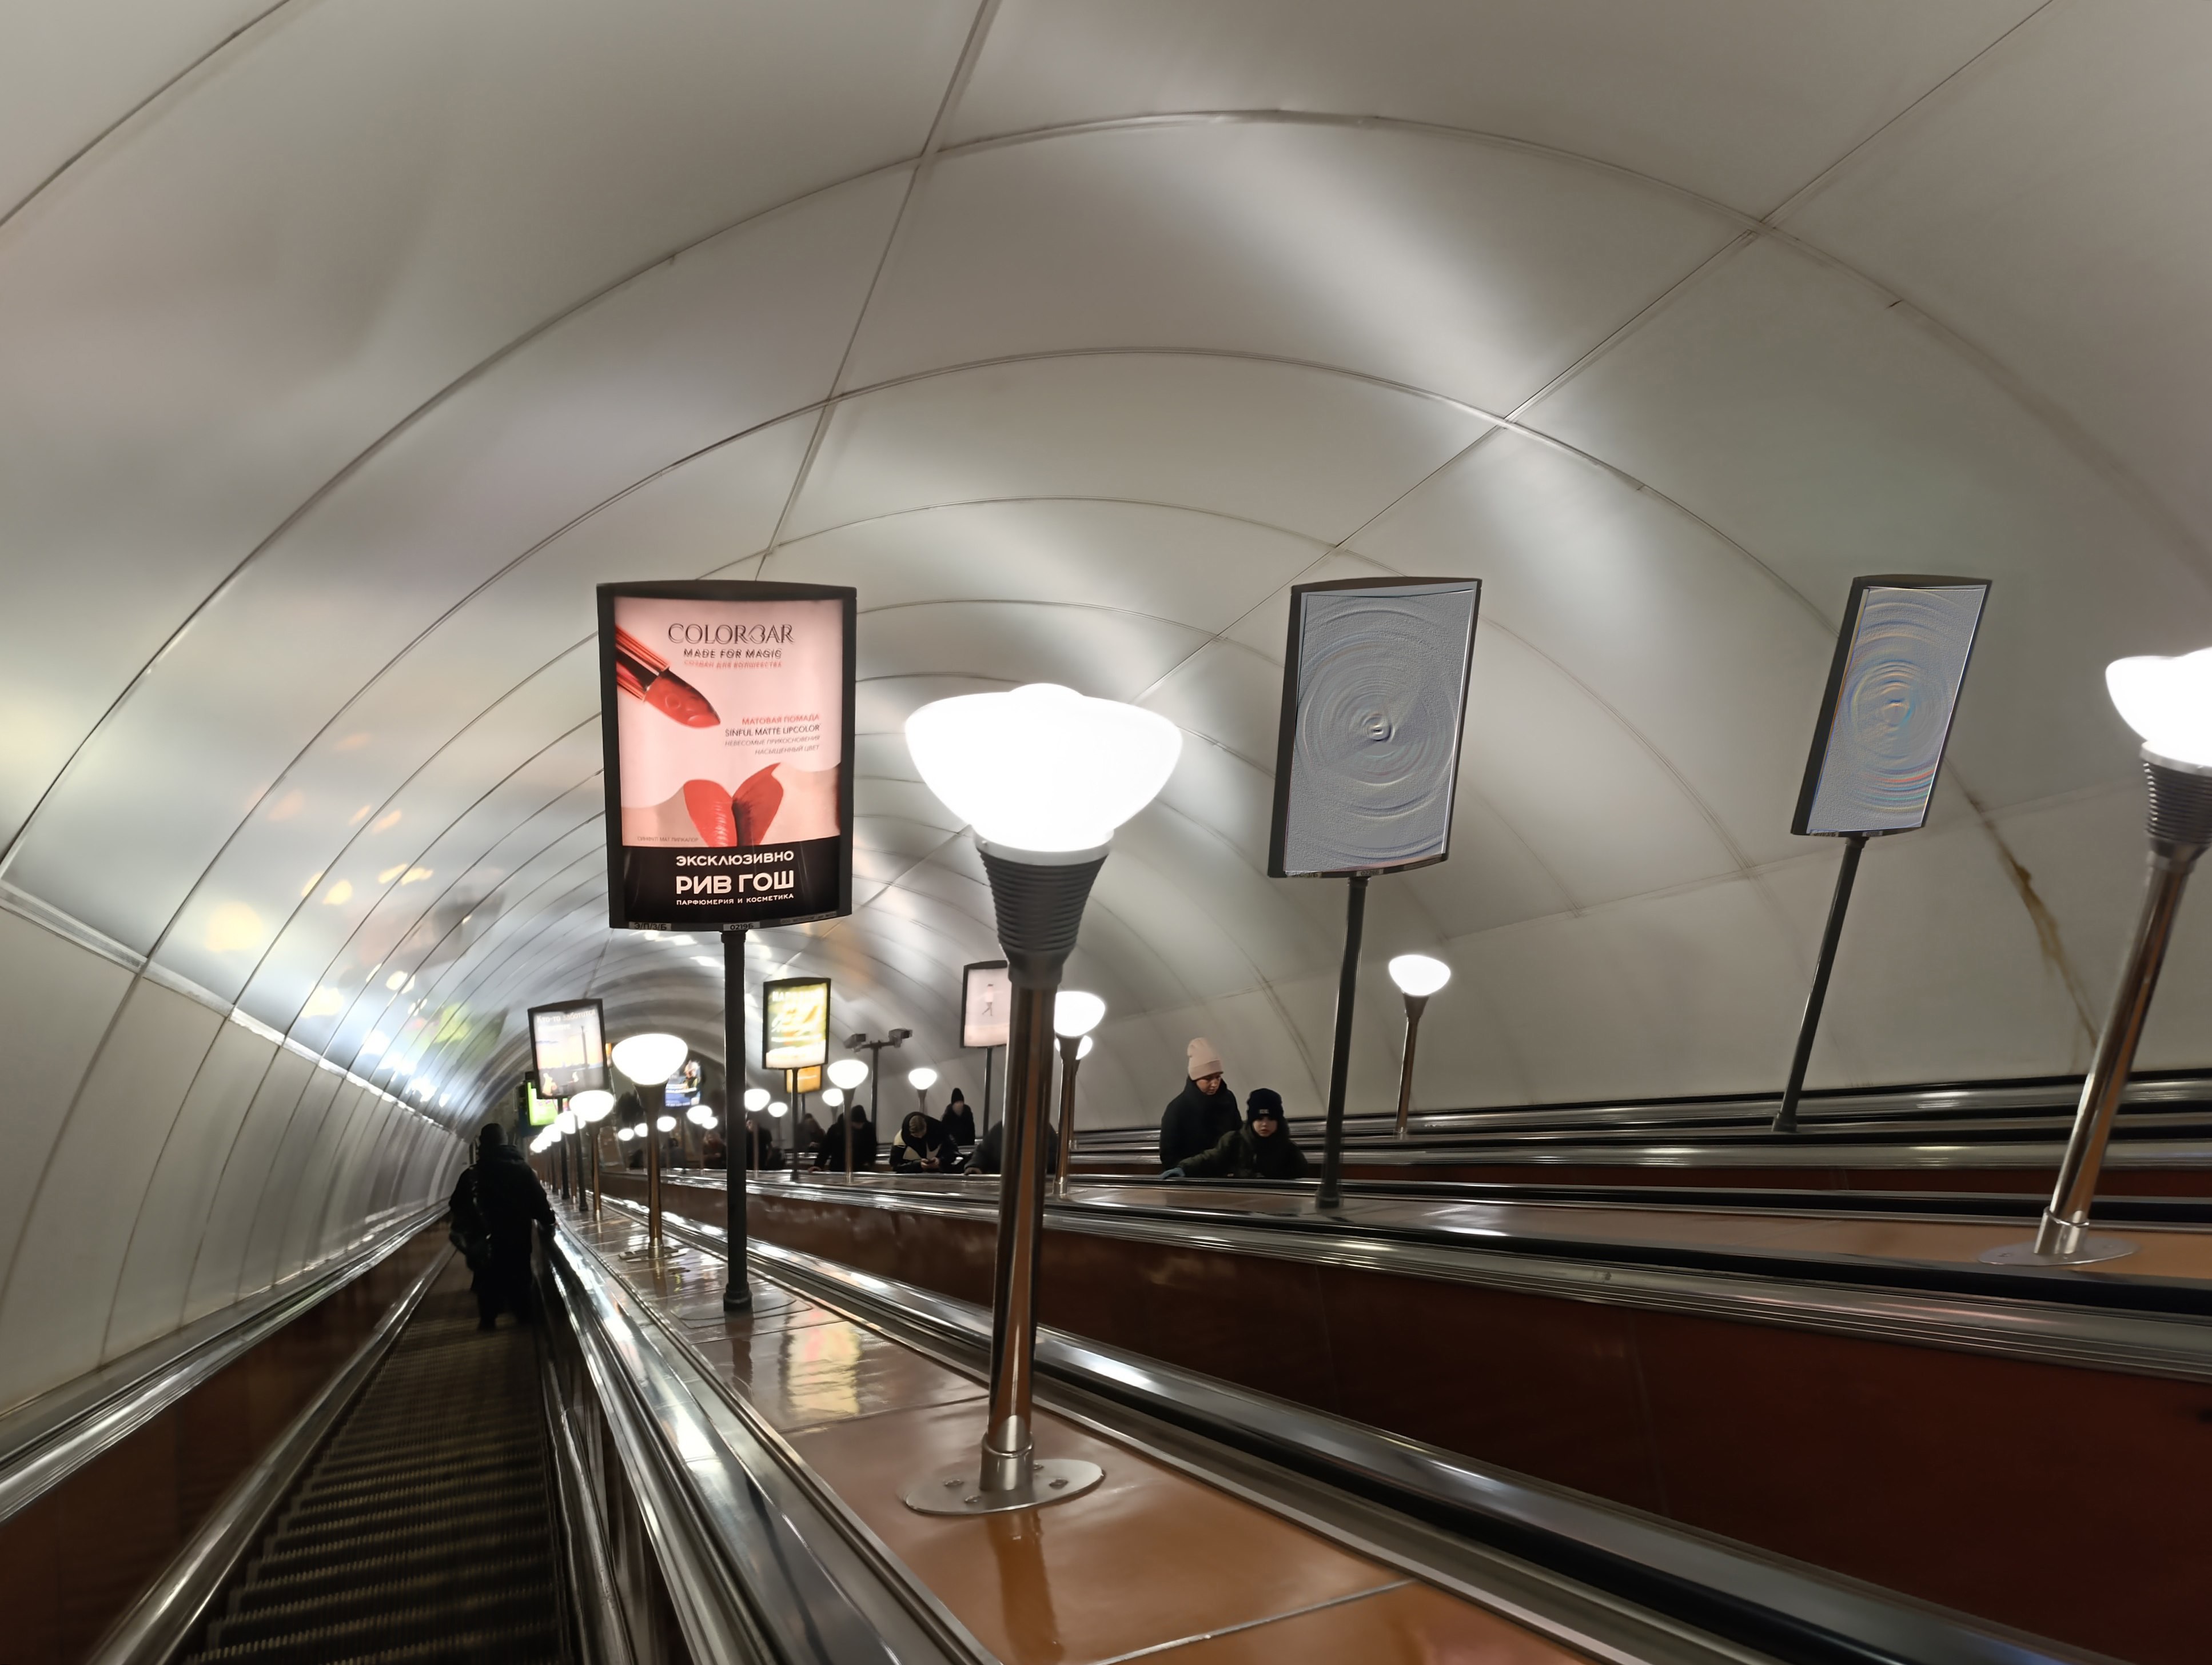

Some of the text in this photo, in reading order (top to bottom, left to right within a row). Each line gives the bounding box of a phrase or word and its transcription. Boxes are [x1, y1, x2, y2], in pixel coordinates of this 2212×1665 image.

[684, 648, 783, 659] MADE FOR MAGIC
[742, 713, 820, 725] МАТОВАЯ ПОМАДА
[725, 724, 820, 737] SINFUL MATTE LIPCOLOR
[676, 850, 795, 867] ЭКСКЛЮЗИВНО
[676, 870, 795, 895] РИВ ГОШ
[746, 893, 794, 904] КОСМЕТИКА
[536, 1015, 561, 1023] Кто-то
